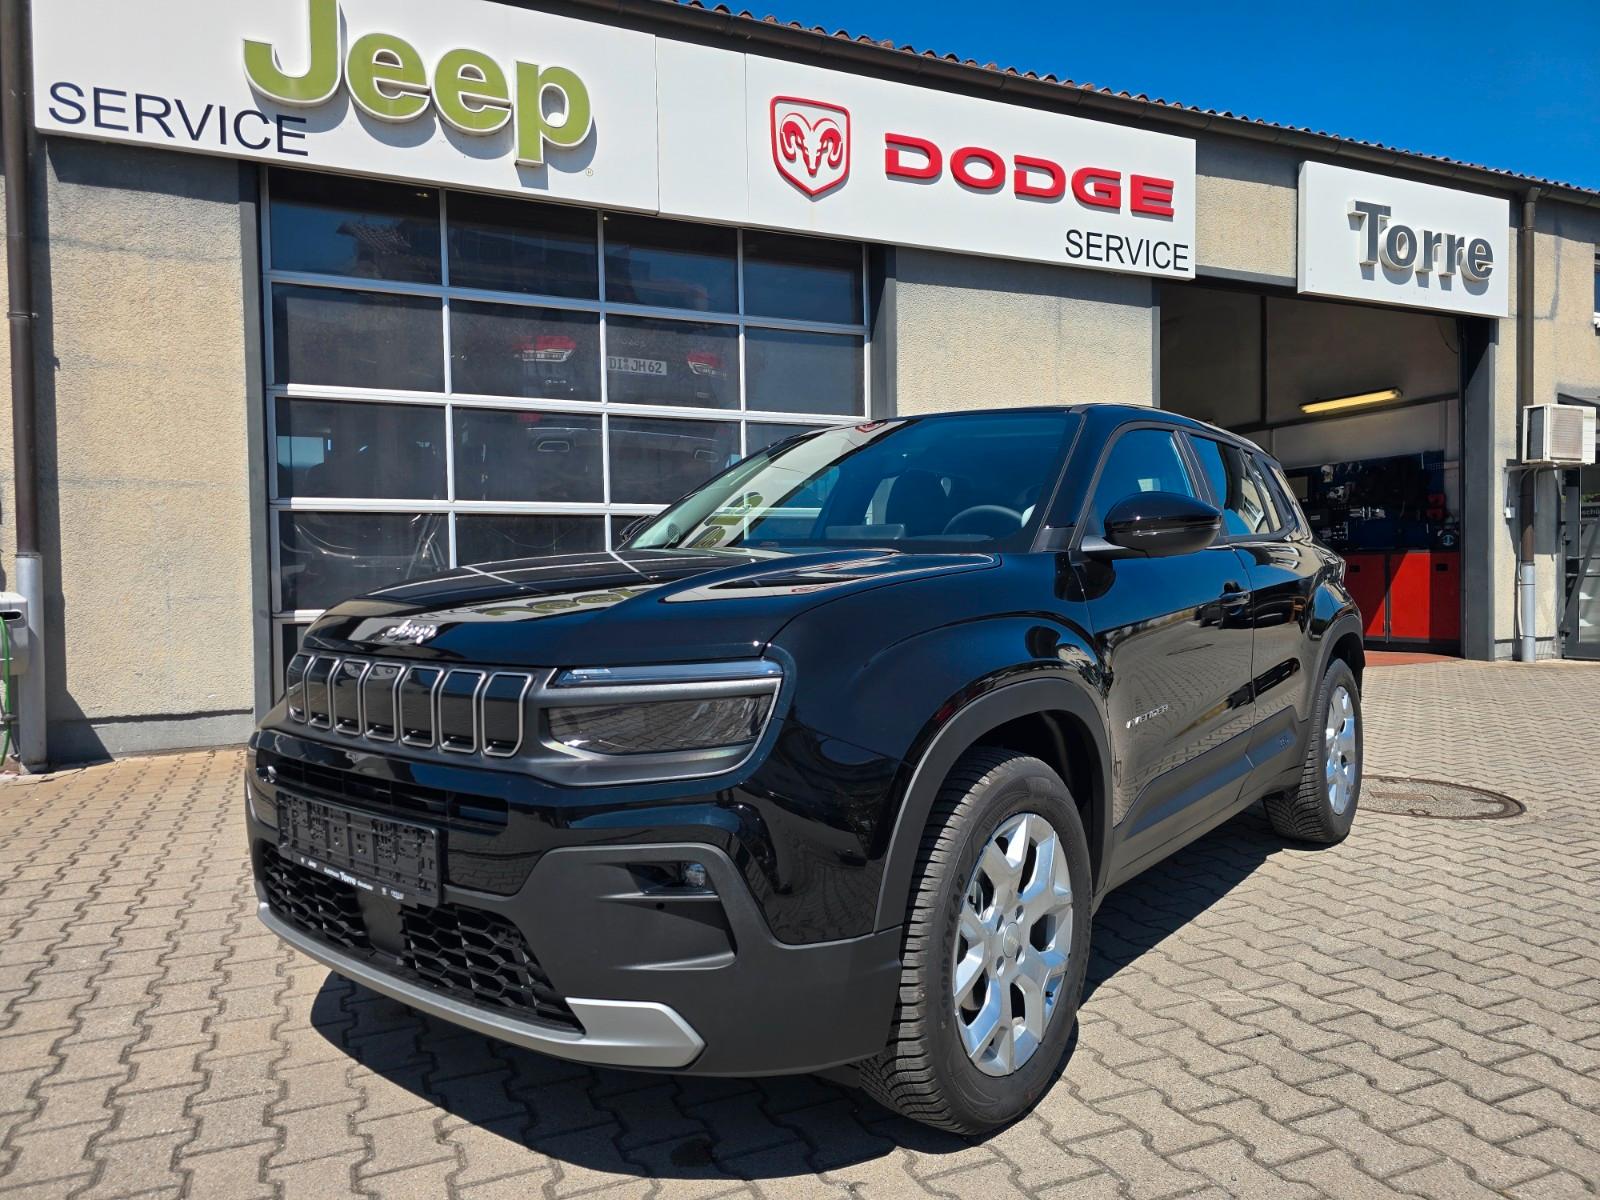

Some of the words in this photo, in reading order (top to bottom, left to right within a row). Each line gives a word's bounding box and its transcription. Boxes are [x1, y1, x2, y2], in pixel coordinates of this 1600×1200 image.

[48, 81, 309, 157] SERVICE
[243, 0, 593, 168] Jeep
[885, 132, 1175, 218] DODGE
[1064, 229, 1190, 272] SERVICE
[1349, 200, 1495, 282] Torre
